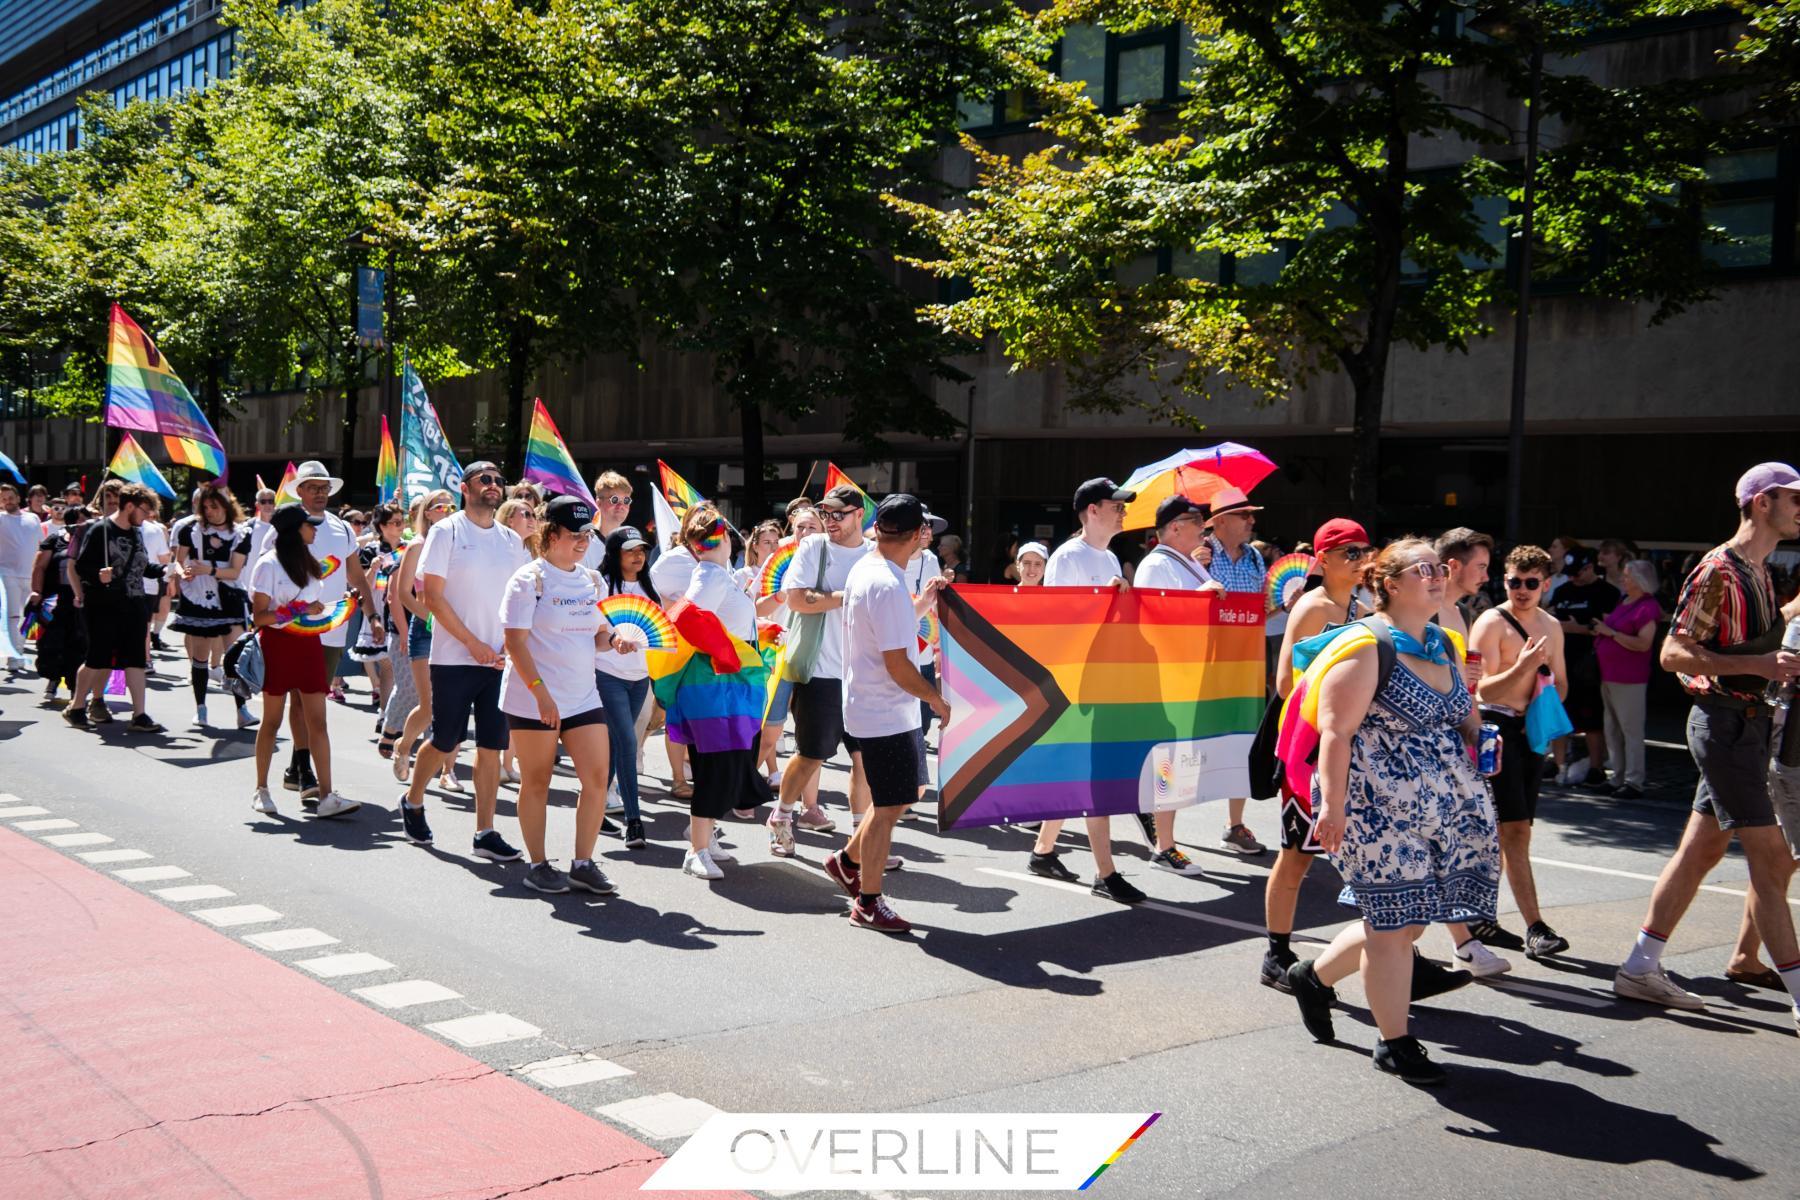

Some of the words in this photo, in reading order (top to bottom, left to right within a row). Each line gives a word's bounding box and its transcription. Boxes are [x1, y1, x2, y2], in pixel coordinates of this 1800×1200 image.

[573, 511, 589, 519] team
[1219, 608, 1237, 622] Pride
[1238, 609, 1246, 622] in
